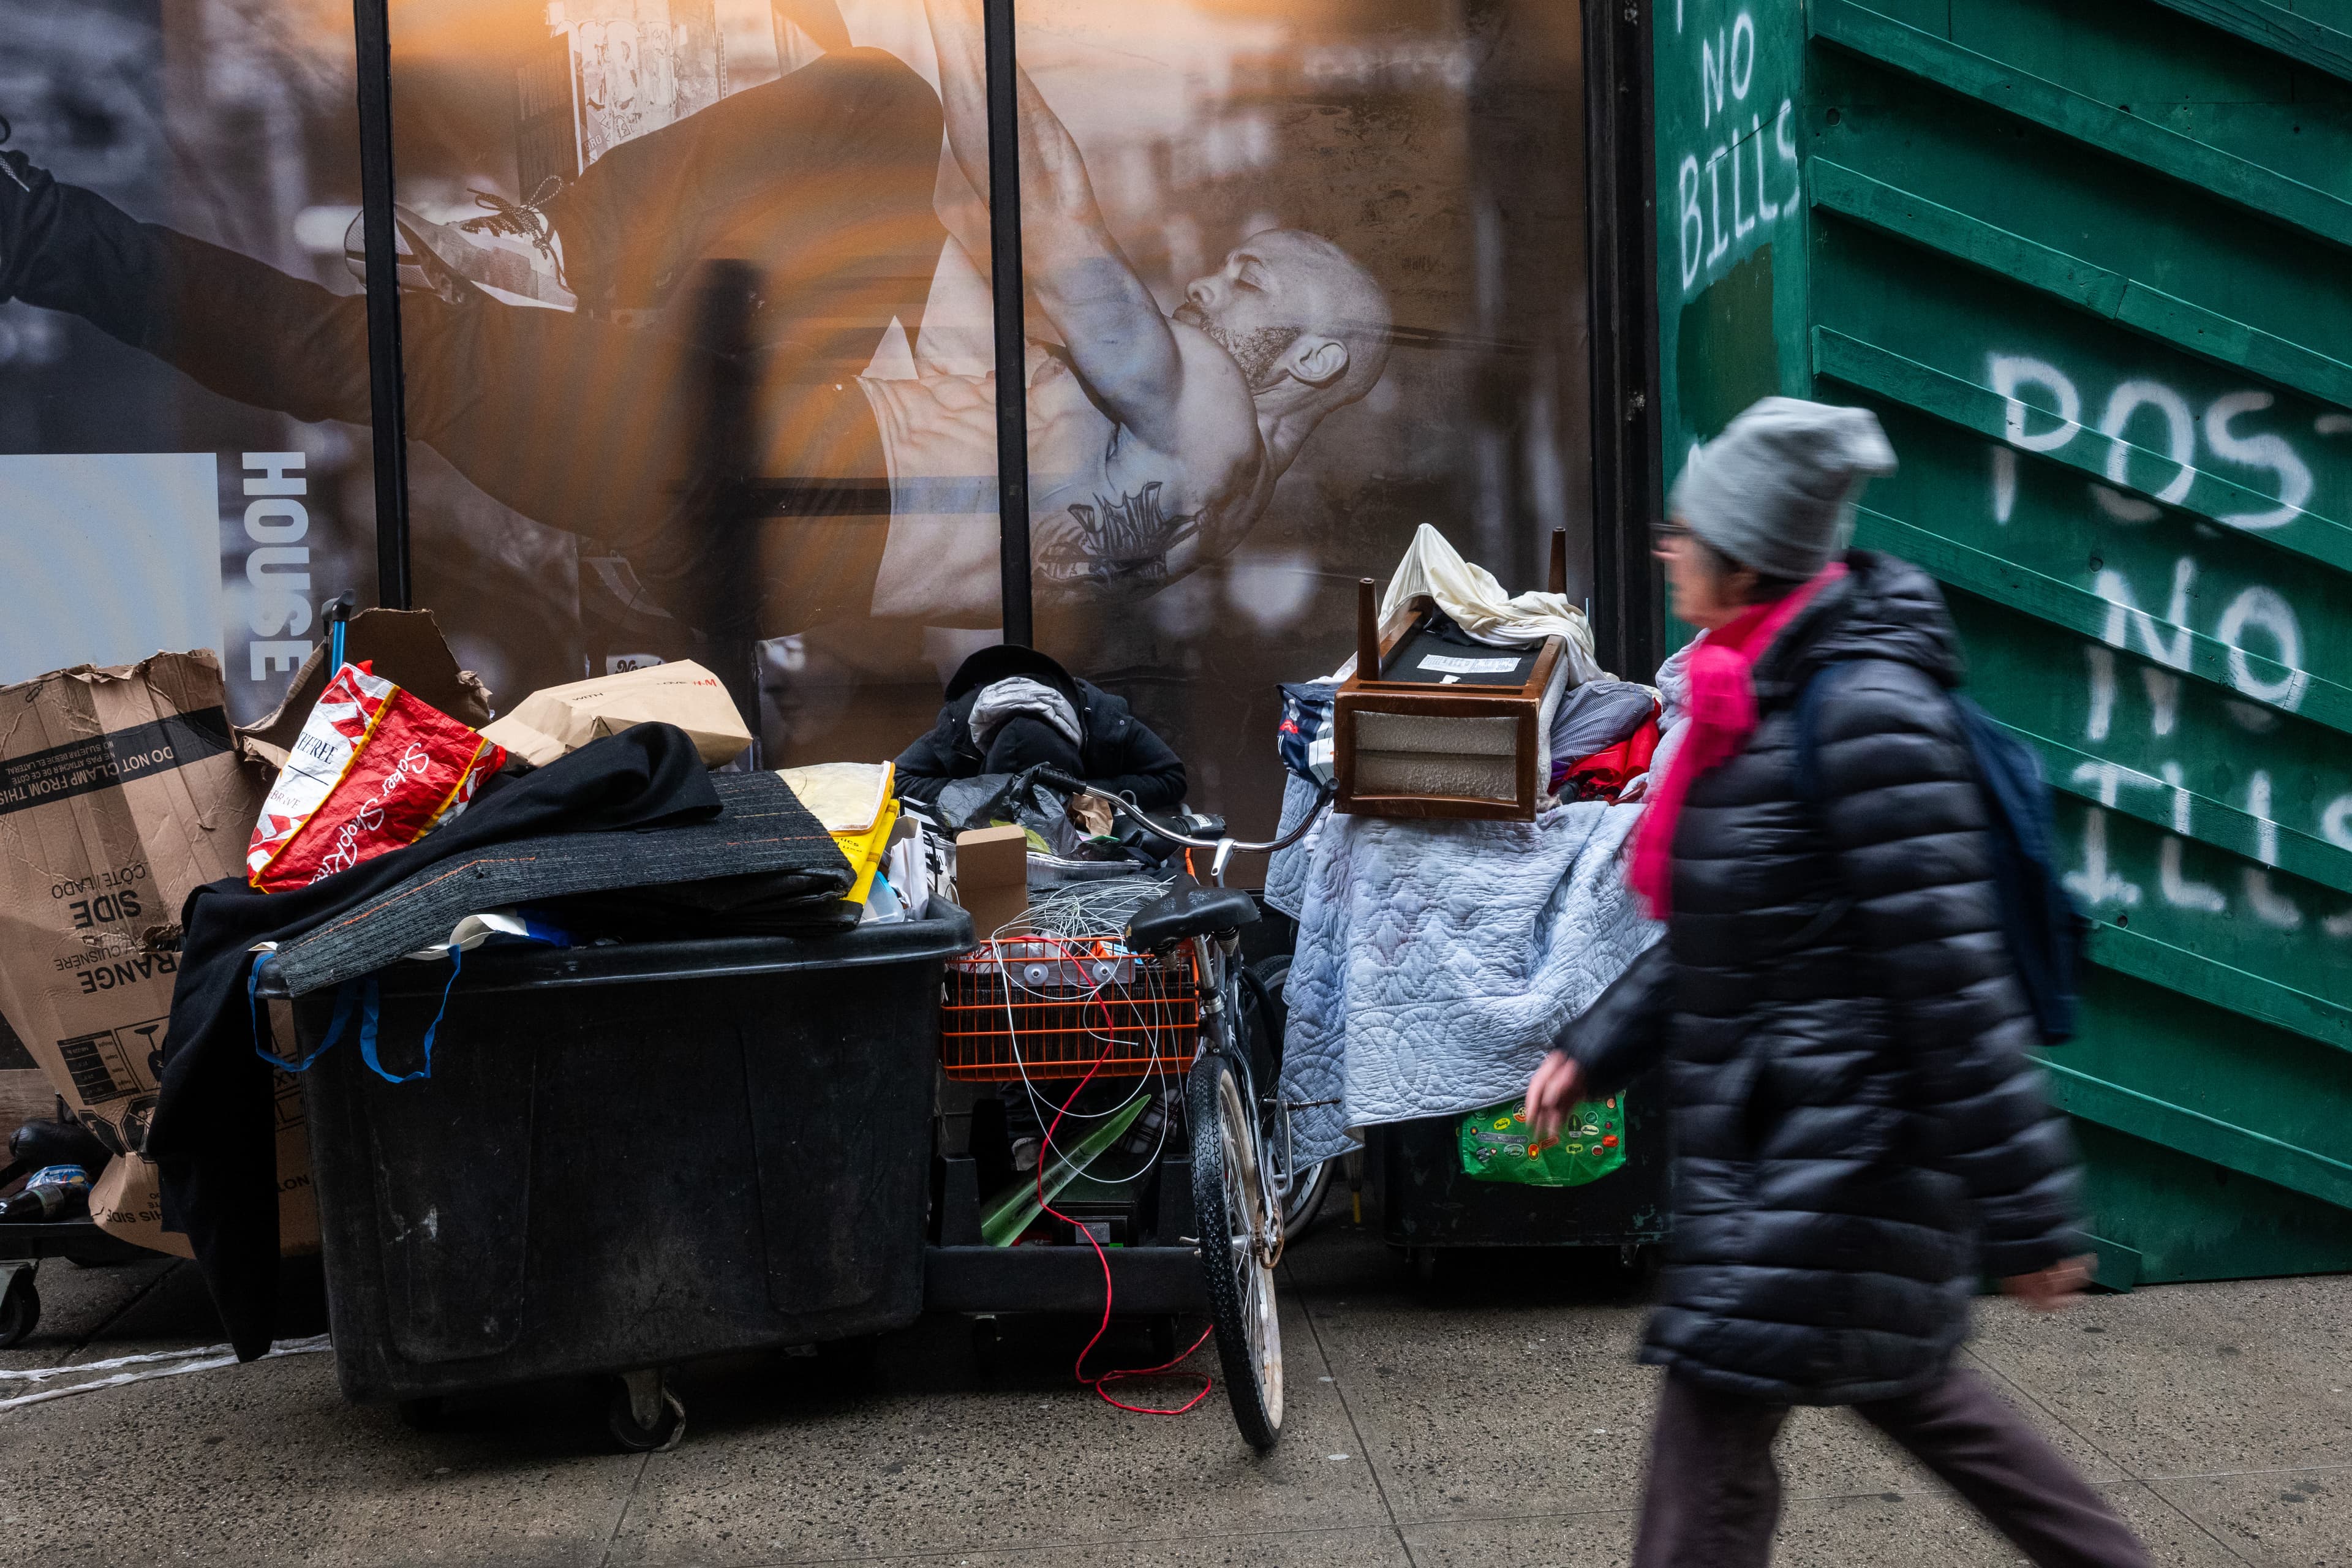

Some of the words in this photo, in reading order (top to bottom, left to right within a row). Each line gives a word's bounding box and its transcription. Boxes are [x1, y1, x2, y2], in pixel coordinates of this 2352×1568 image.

[1702, 12, 1755, 129] NO
[1679, 97, 1801, 292] BILLS
[242, 451, 313, 680] HOUSE
[2088, 556, 2307, 739] NO
[46, 753, 68, 765] DESDE
[69, 744, 101, 758] SUJETAR
[86, 754, 103, 765] PAS
[103, 752, 116, 760] NE
[151, 746, 174, 763] DO
[6, 762, 36, 775] LATERAL
[42, 768, 52, 777] DE
[54, 760, 84, 774] ATTACHER
[123, 753, 150, 772] NOT
[382, 742, 430, 796] Saker
[70, 762, 119, 786] CLAMP
[28, 775, 69, 796] FROM
[51, 878, 96, 899] LADO
[69, 890, 141, 929] SIDE
[77, 953, 178, 994] RANGE
[107, 1209, 136, 1223] SIDE
